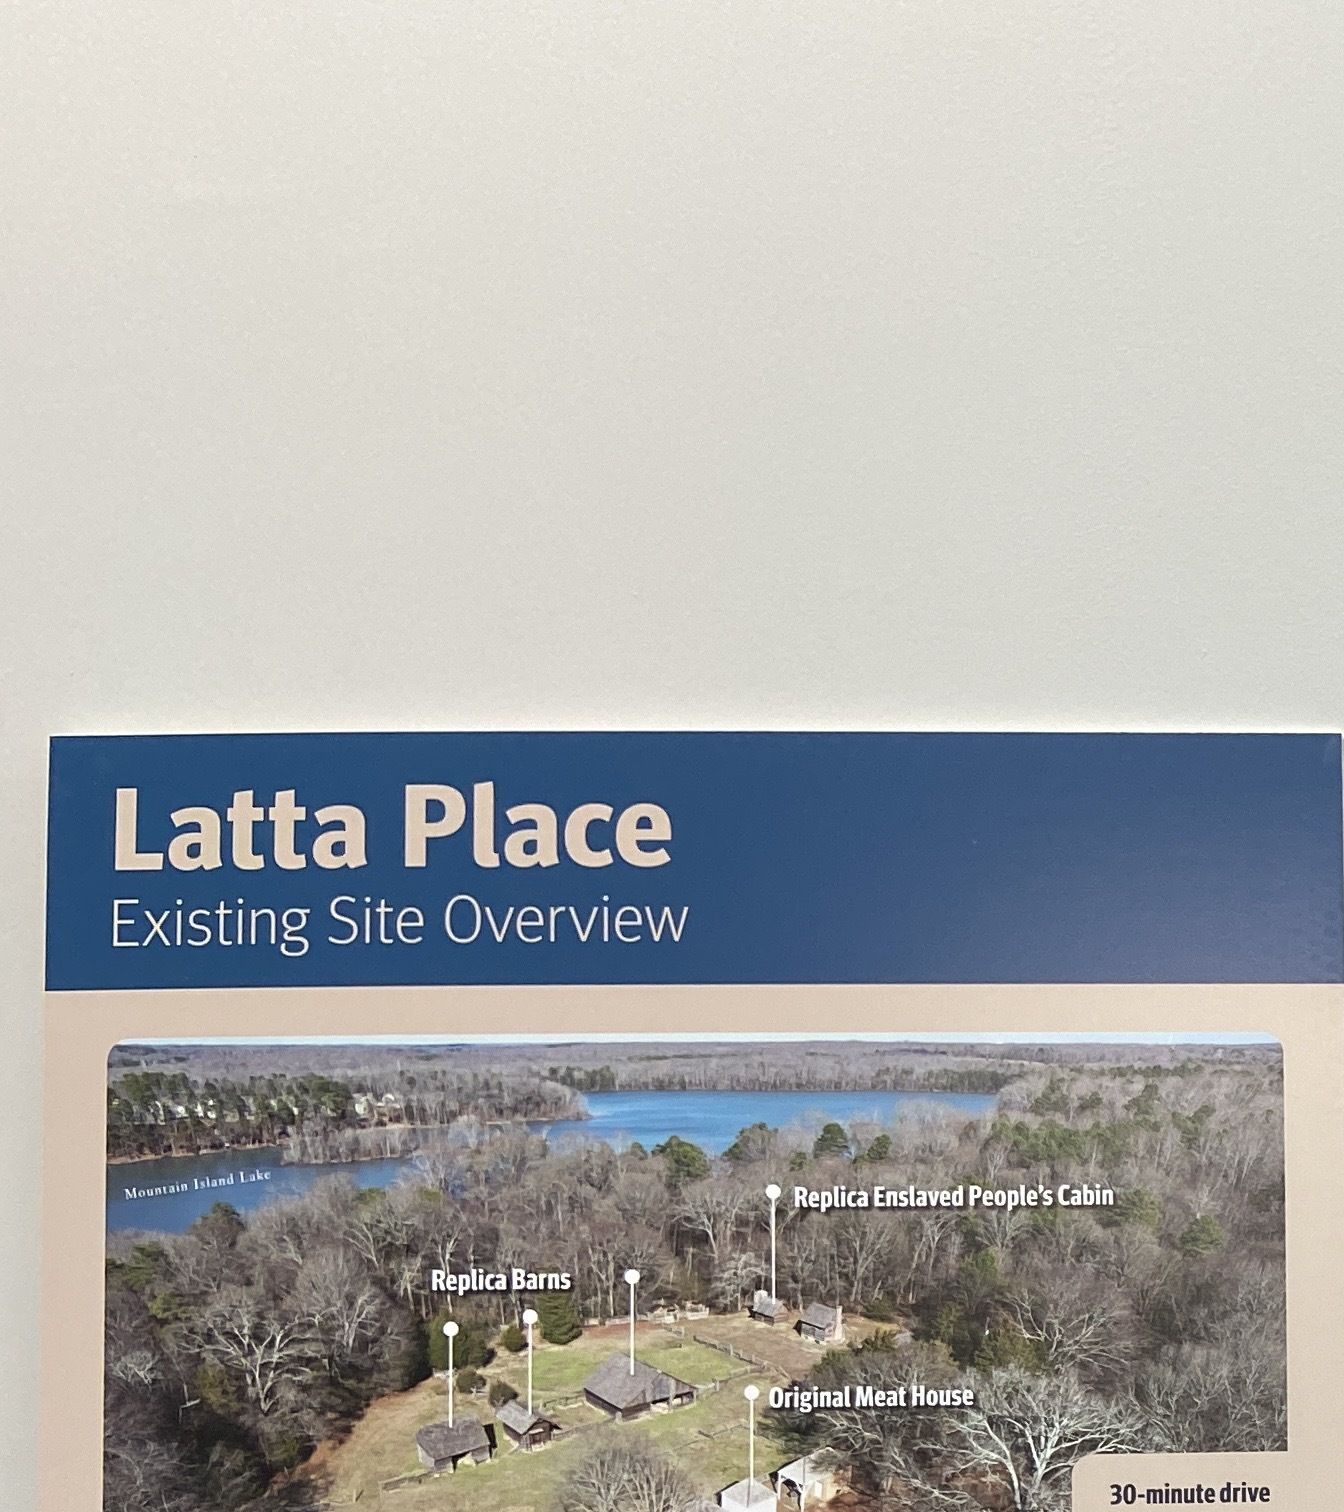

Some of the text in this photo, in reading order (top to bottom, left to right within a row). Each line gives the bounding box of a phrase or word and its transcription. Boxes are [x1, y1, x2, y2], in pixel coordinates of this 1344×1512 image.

[113, 780, 672, 871] Latta Place
[112, 893, 689, 957] Existing Site Overview
[123, 1168, 271, 1200] Mountain Island Lake
[793, 1184, 869, 1213] Replica
[872, 1183, 964, 1207] Enslaved
[1056, 1182, 1114, 1206] Cabin
[430, 1266, 571, 1295] Replica Barns
[767, 1383, 974, 1413] Original Meat House
[1108, 1480, 1271, 1506] 30-minute drive
